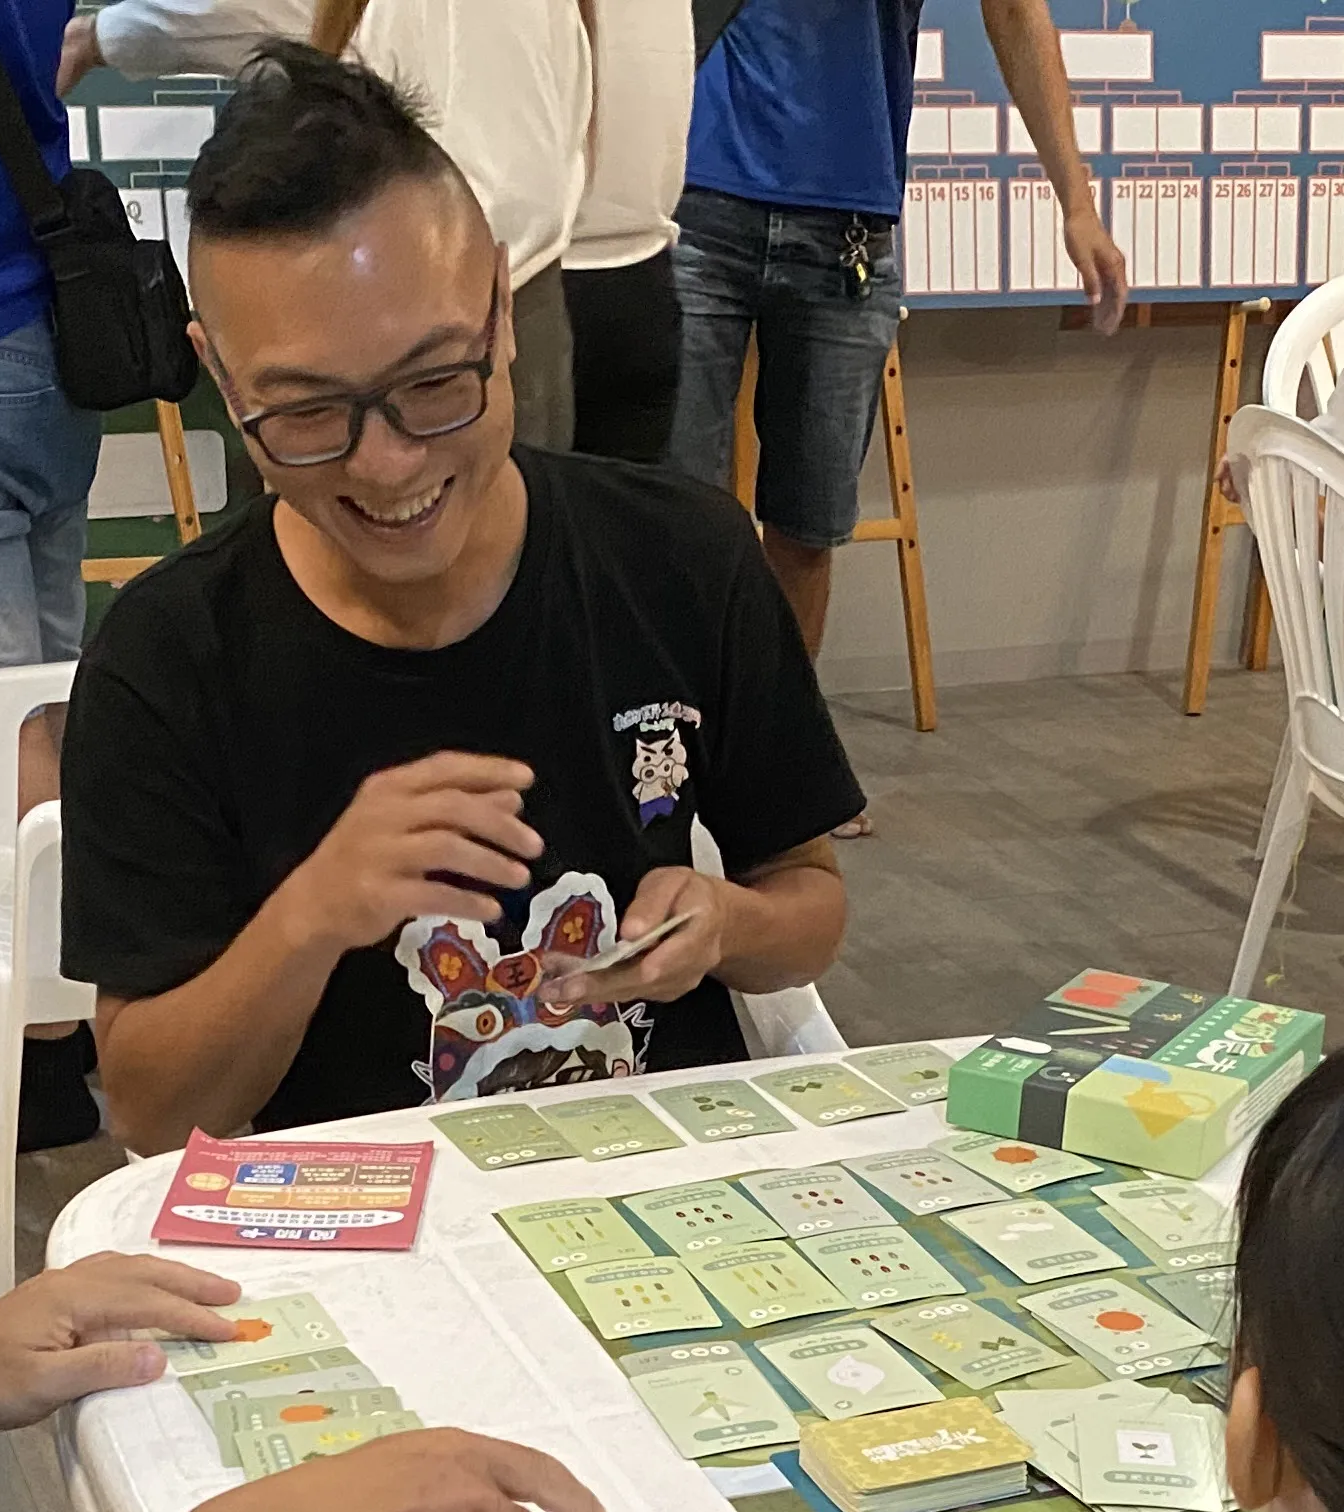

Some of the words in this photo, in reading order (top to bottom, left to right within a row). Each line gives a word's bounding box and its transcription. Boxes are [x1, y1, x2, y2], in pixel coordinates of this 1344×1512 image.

[908, 187, 923, 201] 13
[930, 187, 945, 200] 14
[954, 186, 969, 200] 15
[979, 186, 994, 200] 16
[1013, 186, 1027, 200] 17
[1036, 186, 1051, 199] 18
[1117, 185, 1131, 198] 21
[1139, 185, 1153, 198] 22
[1161, 185, 1176, 198] 23
[1183, 184, 1198, 198] 24
[1216, 184, 1230, 197] 25
[1237, 184, 1251, 197] 26
[1259, 184, 1274, 197] 27
[1281, 183, 1295, 196] 28
[1312, 183, 1326, 196] 29
[126, 200, 143, 225] Q
